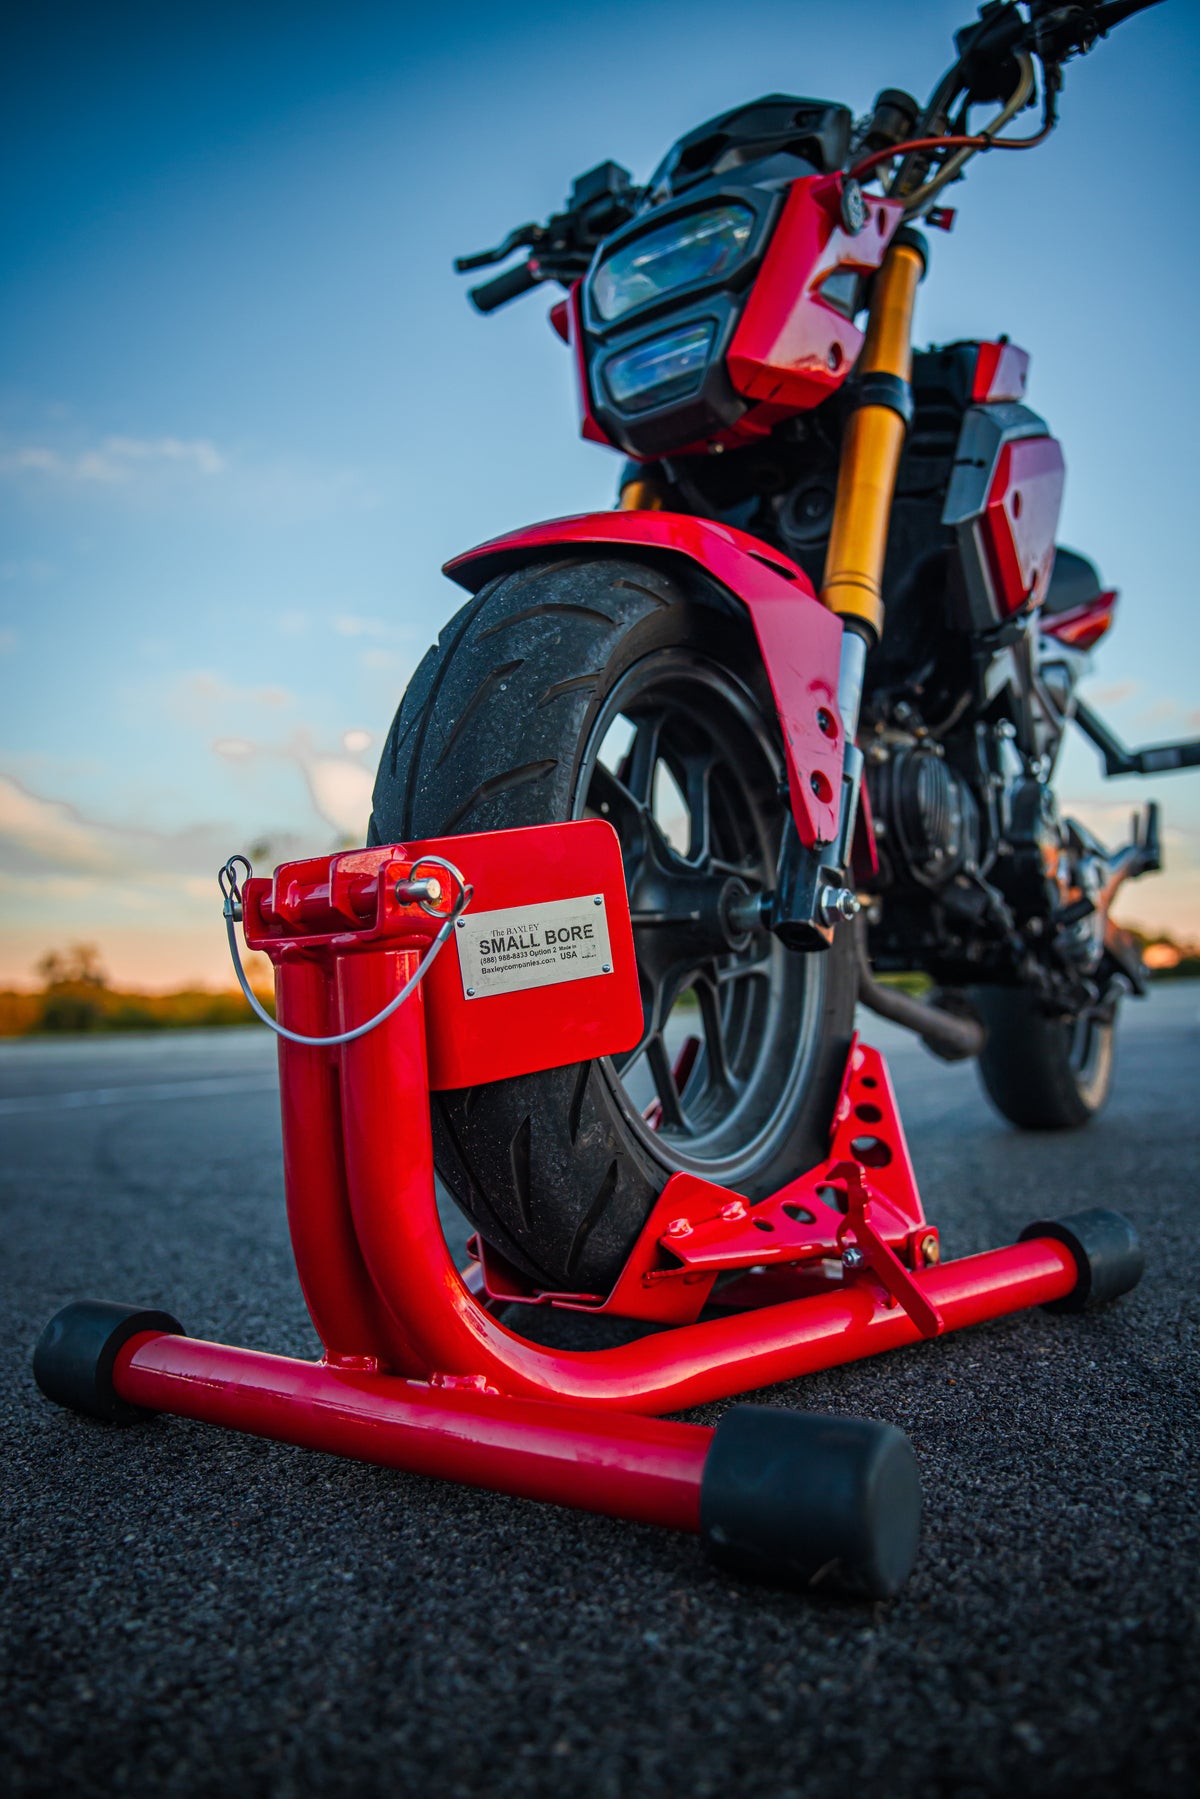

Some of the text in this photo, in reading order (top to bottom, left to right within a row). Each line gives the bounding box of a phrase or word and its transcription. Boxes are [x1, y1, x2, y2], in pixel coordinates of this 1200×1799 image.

[490, 923, 539, 937] The BAXLEY
[479, 924, 594, 955] SMALL BORE
[480, 956, 497, 966] (888)
[529, 947, 551, 957] Option
[560, 951, 578, 960] USA
[481, 957, 556, 975] Baxleycompanies.com
